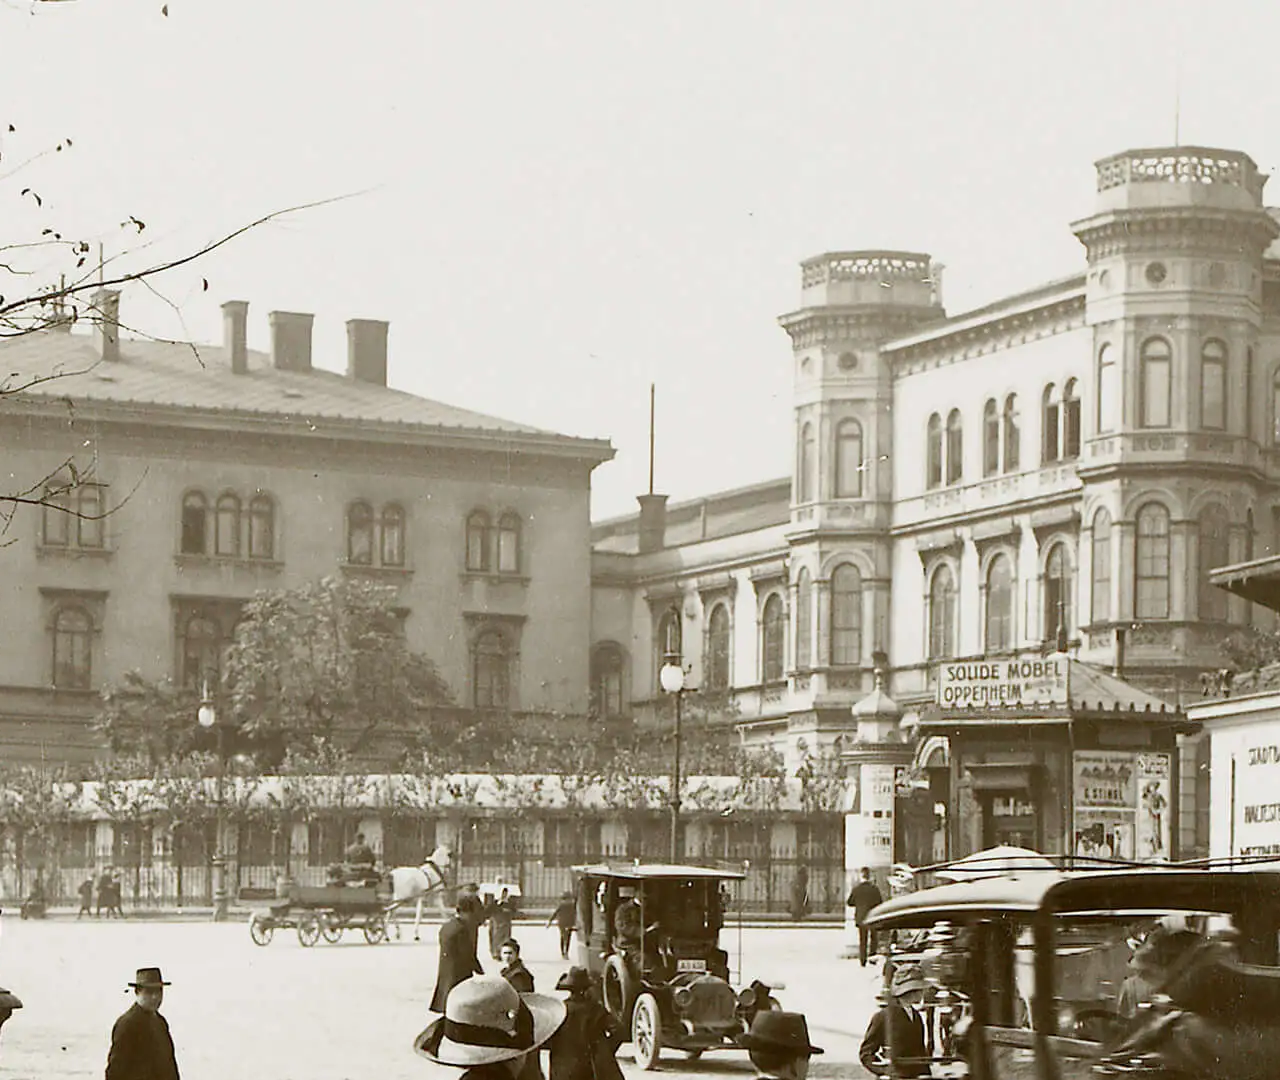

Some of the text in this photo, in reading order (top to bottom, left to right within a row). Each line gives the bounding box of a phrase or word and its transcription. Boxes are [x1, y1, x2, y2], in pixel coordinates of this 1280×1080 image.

[947, 659, 1062, 681] SOLIDE MÖBEL
[943, 683, 1022, 702] OPPENHEIM
